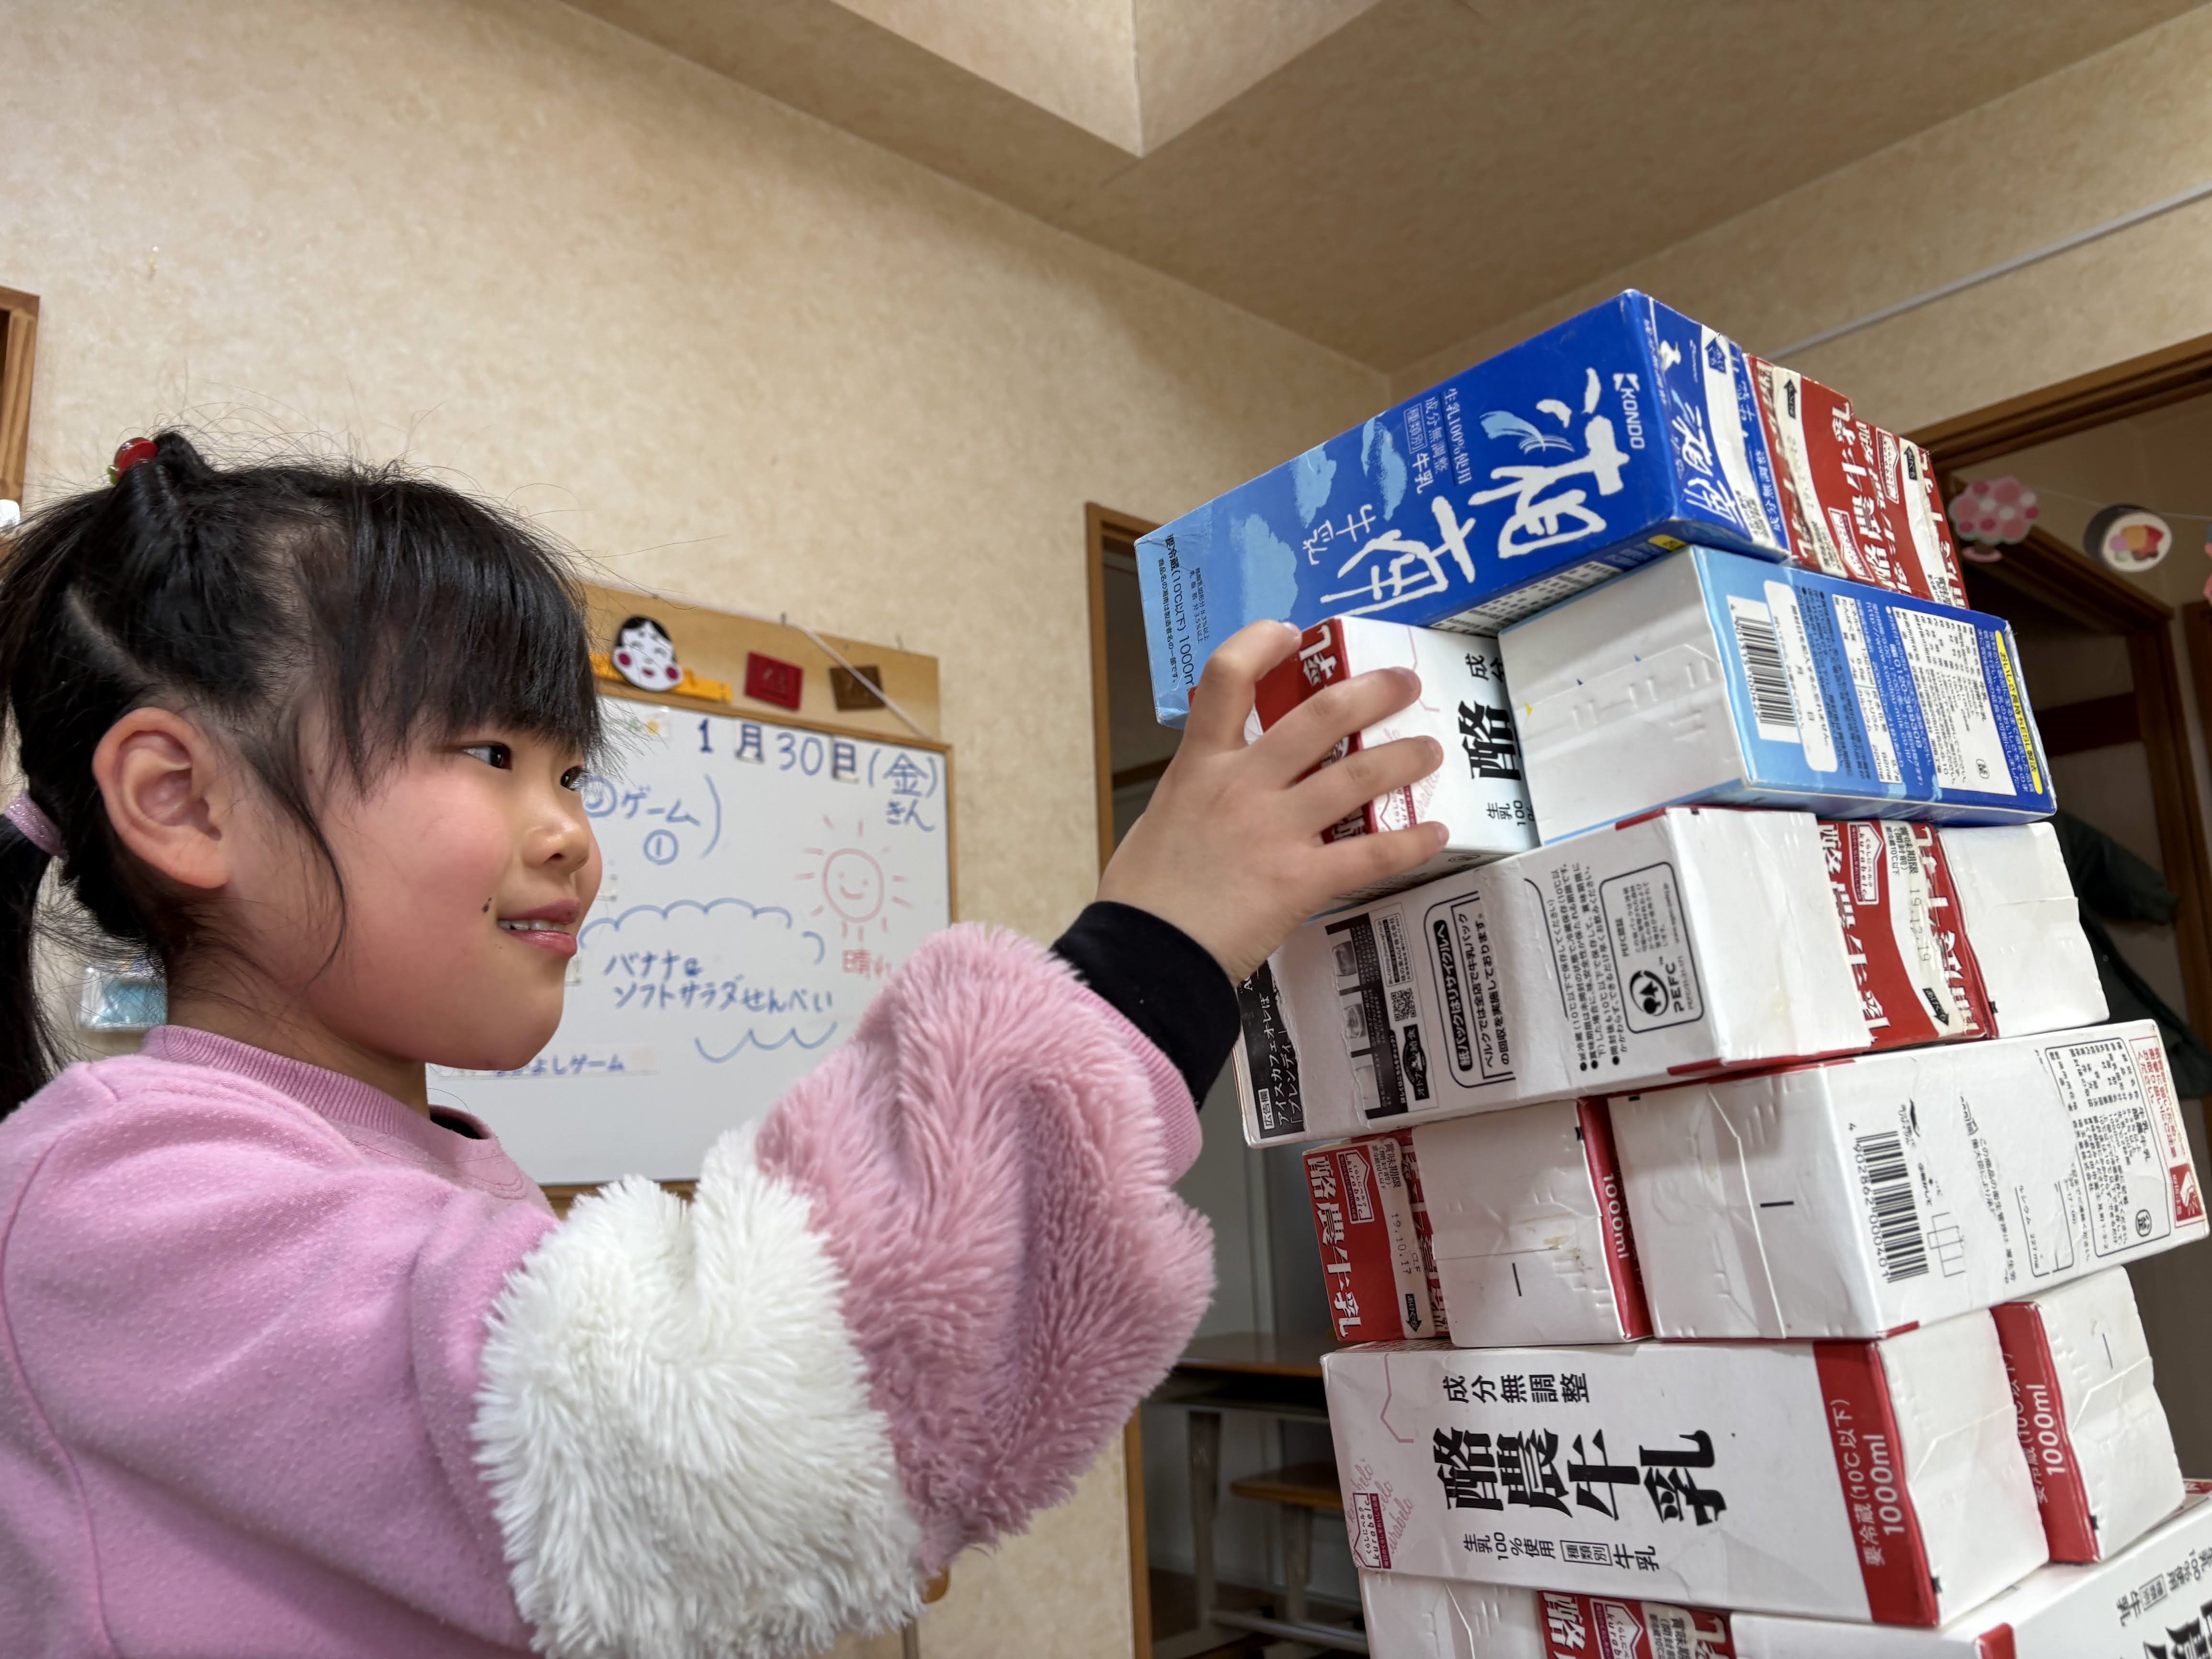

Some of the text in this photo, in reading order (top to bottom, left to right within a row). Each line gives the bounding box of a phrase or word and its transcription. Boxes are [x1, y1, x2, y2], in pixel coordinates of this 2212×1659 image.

[1405, 405, 1434, 495] 種類別 牛乳
[1422, 395, 1449, 475] 成分無調整
[1442, 386, 1472, 485] 生乳100%使用
[1321, 367, 1630, 615] 湘南
[1156, 557, 1180, 683] 商品名の湘南は製造者名の一部です。
[613, 974, 832, 1014] ソフトサラダせんべい
[1436, 923, 1471, 1067] 紙パックはリサイクルへ
[1458, 912, 1494, 1068] ベルクでは全店で牛乳パック
[1474, 913, 1510, 1066] の回収を実施しております。
[1665, 962, 1685, 1012] PEFC
[1260, 995, 1288, 1125] アイスカフェオレは
[1259, 1090, 1273, 1127] 広告欄
[1307, 1155, 1362, 1339] 酪農牛乳
[1390, 1212, 1411, 1274] 19.10.17
[1603, 1172, 1630, 1259] 1000ml
[1852, 1144, 1874, 1207] 902862
[1868, 1213, 1890, 1279] 000401
[1442, 1372, 1591, 1404] 成分無調整
[2026, 1384, 2067, 1477] 1000ml
[1432, 1426, 1727, 1526] 酪農牛乳
[1829, 1399, 1885, 1566] 要冷蔵(10℃以下)
[1862, 1434, 1905, 1536] 1000ml
[1358, 1506, 1371, 1554] くらしにベルク
[1463, 1531, 1660, 1573] 生乳100%使用 種類別 牛乳
[1543, 1592, 1585, 1659] 酪
